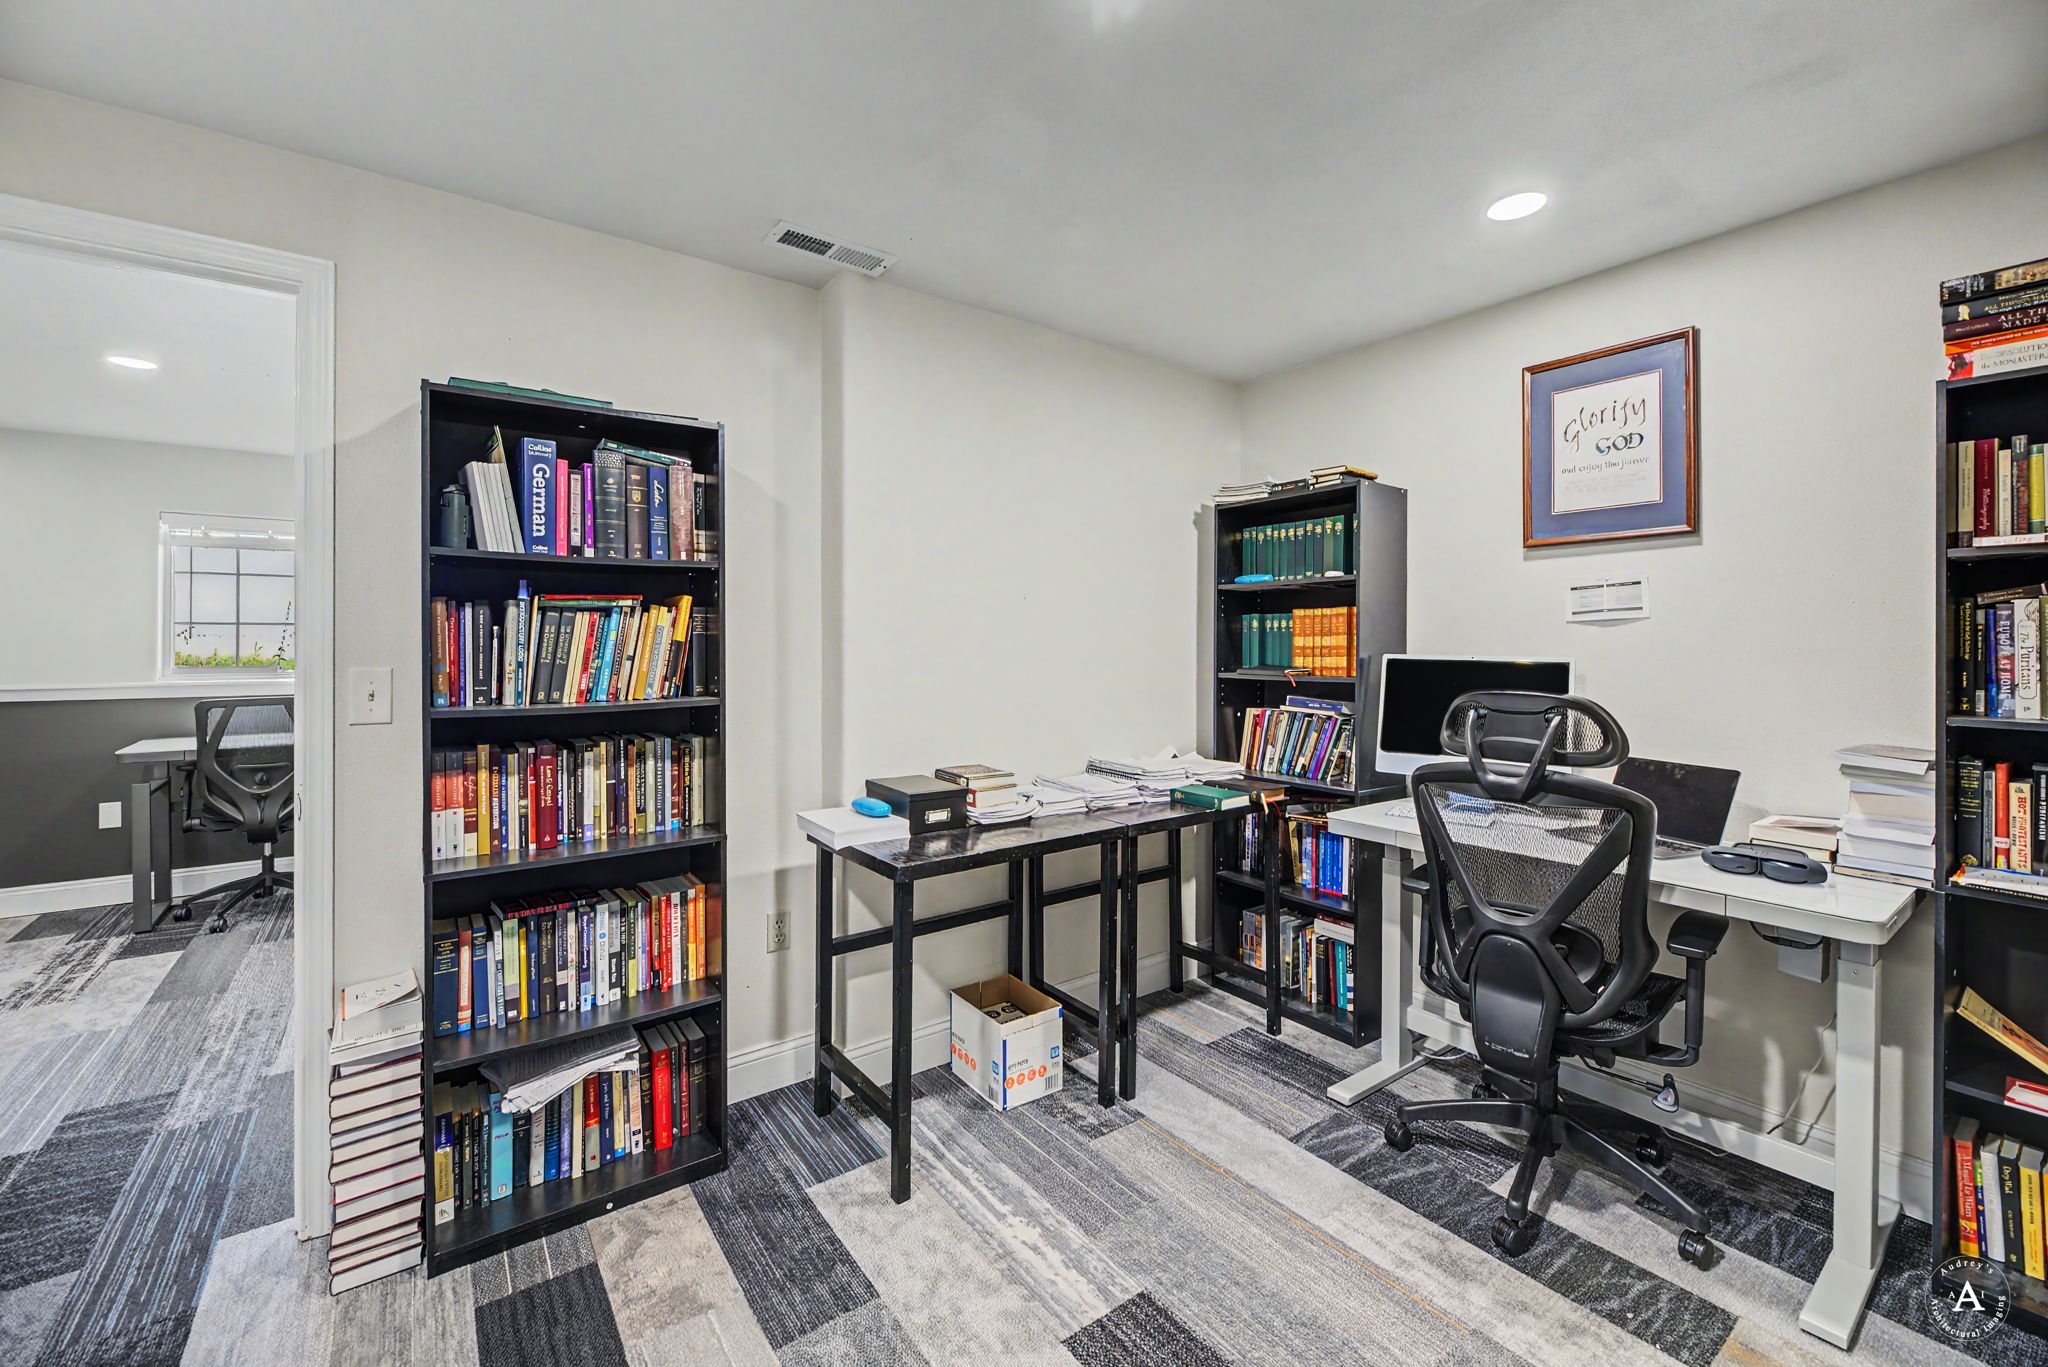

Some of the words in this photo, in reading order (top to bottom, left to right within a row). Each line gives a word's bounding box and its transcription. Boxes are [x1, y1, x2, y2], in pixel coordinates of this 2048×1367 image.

[1998, 311, 2023, 321] ALL
[2002, 315, 2041, 329] MADE
[1564, 397, 1646, 453] Glorify
[1595, 432, 1644, 456] GOD
[1561, 465, 1576, 474] and
[1579, 463, 1602, 473] enjoy
[533, 463, 550, 537] German
[1998, 621, 2011, 656] EUROPE
[2020, 632, 2030, 643] The
[1999, 658, 2010, 669] AT
[2020, 646, 2034, 690] Puritans
[1999, 672, 2011, 699] HOME
[2018, 797, 2027, 815] HOT
[2018, 816, 2028, 869] PROTESTANTS
[1964, 1161, 1974, 1185] Manual
[2002, 1165, 2012, 1180] Deep
[1966, 1196, 1975, 1218] Writers
